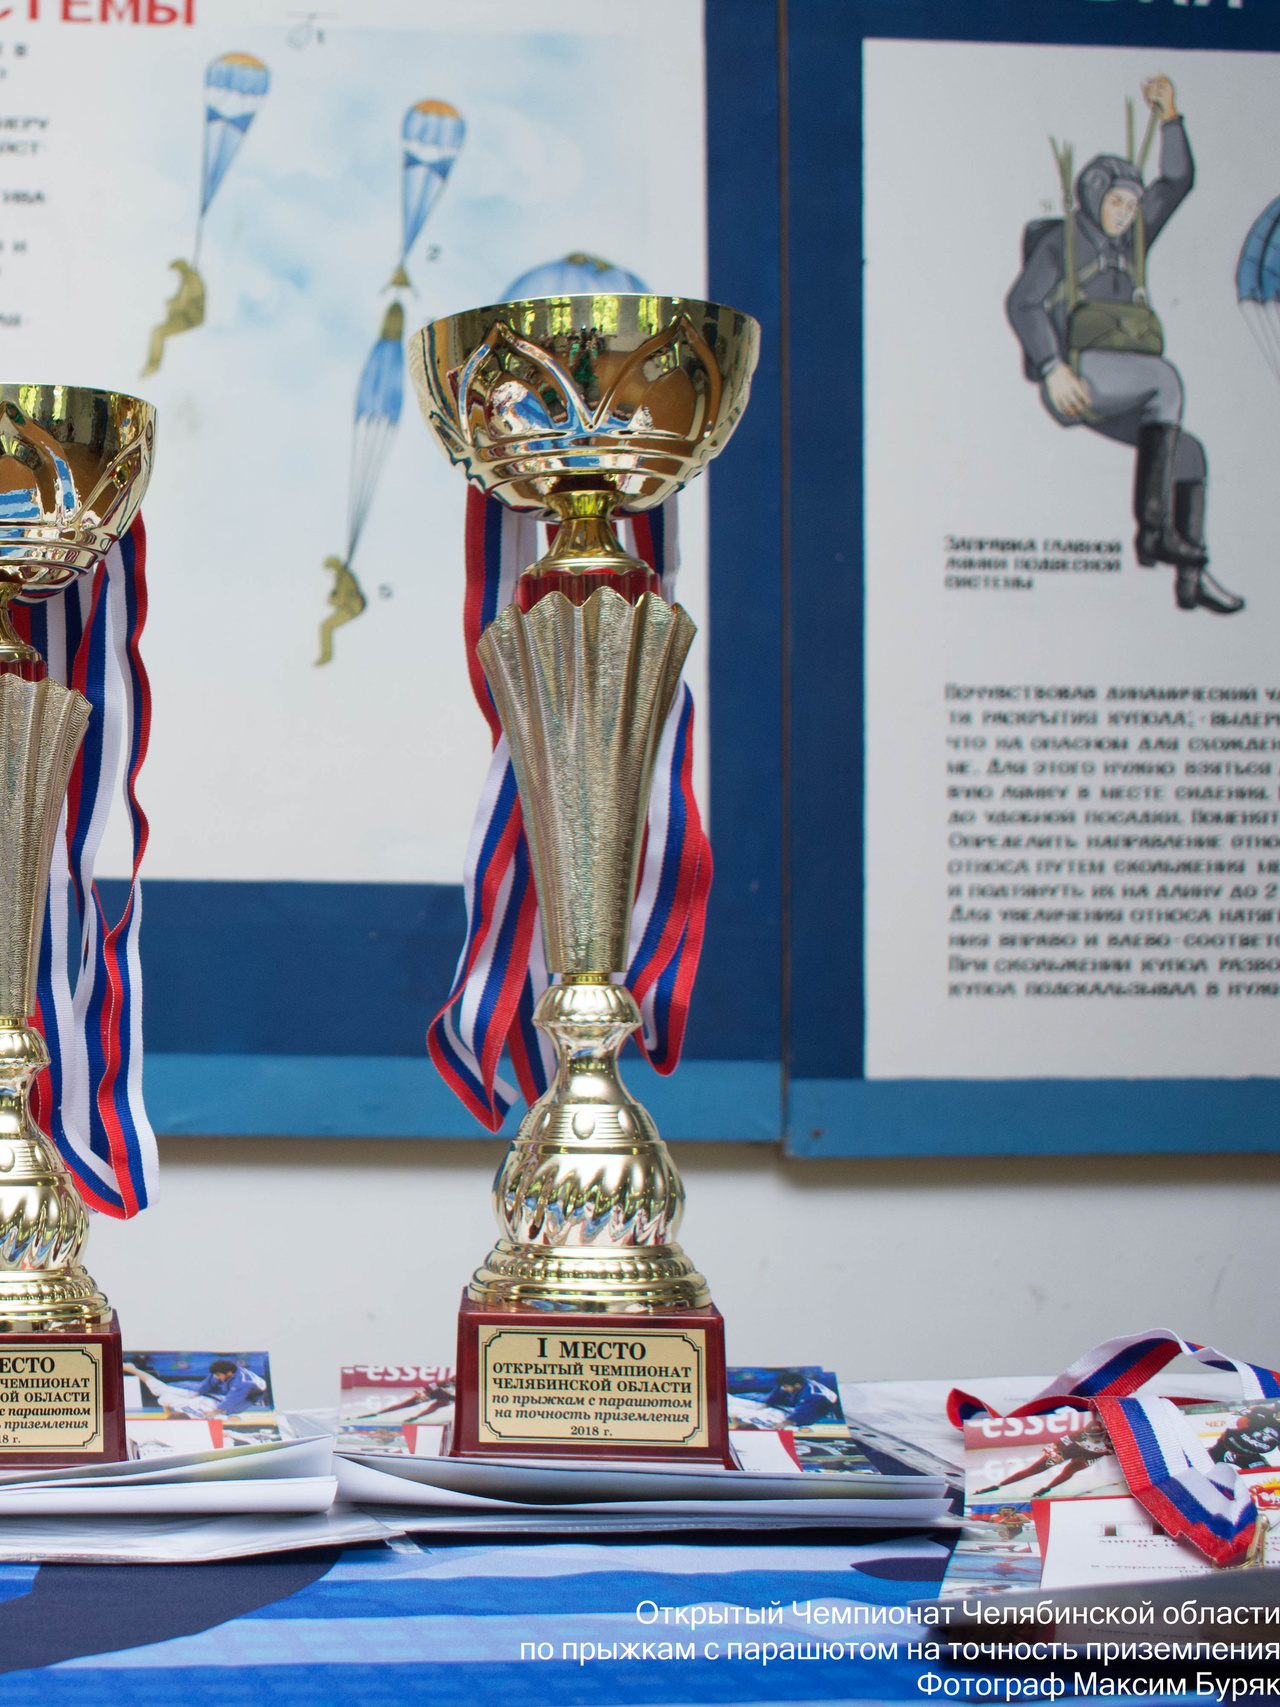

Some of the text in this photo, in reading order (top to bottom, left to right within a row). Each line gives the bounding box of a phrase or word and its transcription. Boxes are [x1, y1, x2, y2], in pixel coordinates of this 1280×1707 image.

[538, 1337, 647, 1361] I МЕСТО
[493, 1361, 691, 1377] ОТКРЫТЫЙ ЧЕМПИОНАТ
[0, 1378, 90, 1388] ЧЕМПИОНАТ
[494, 1378, 692, 1393] ЧЕЛЯБИНСКОЙ ОБЛАСТИ
[24, 1392, 90, 1402] ОБЛАСТИ
[492, 1395, 692, 1410] по прыжкам с парашютом
[0, 1407, 5, 1417] с
[8, 1407, 91, 1419] парашютом
[495, 1409, 689, 1424] на точность приземления
[4, 1420, 88, 1432] приземления
[571, 1425, 613, 1438] 2018 г.
[13, 1434, 22, 1446] г.
